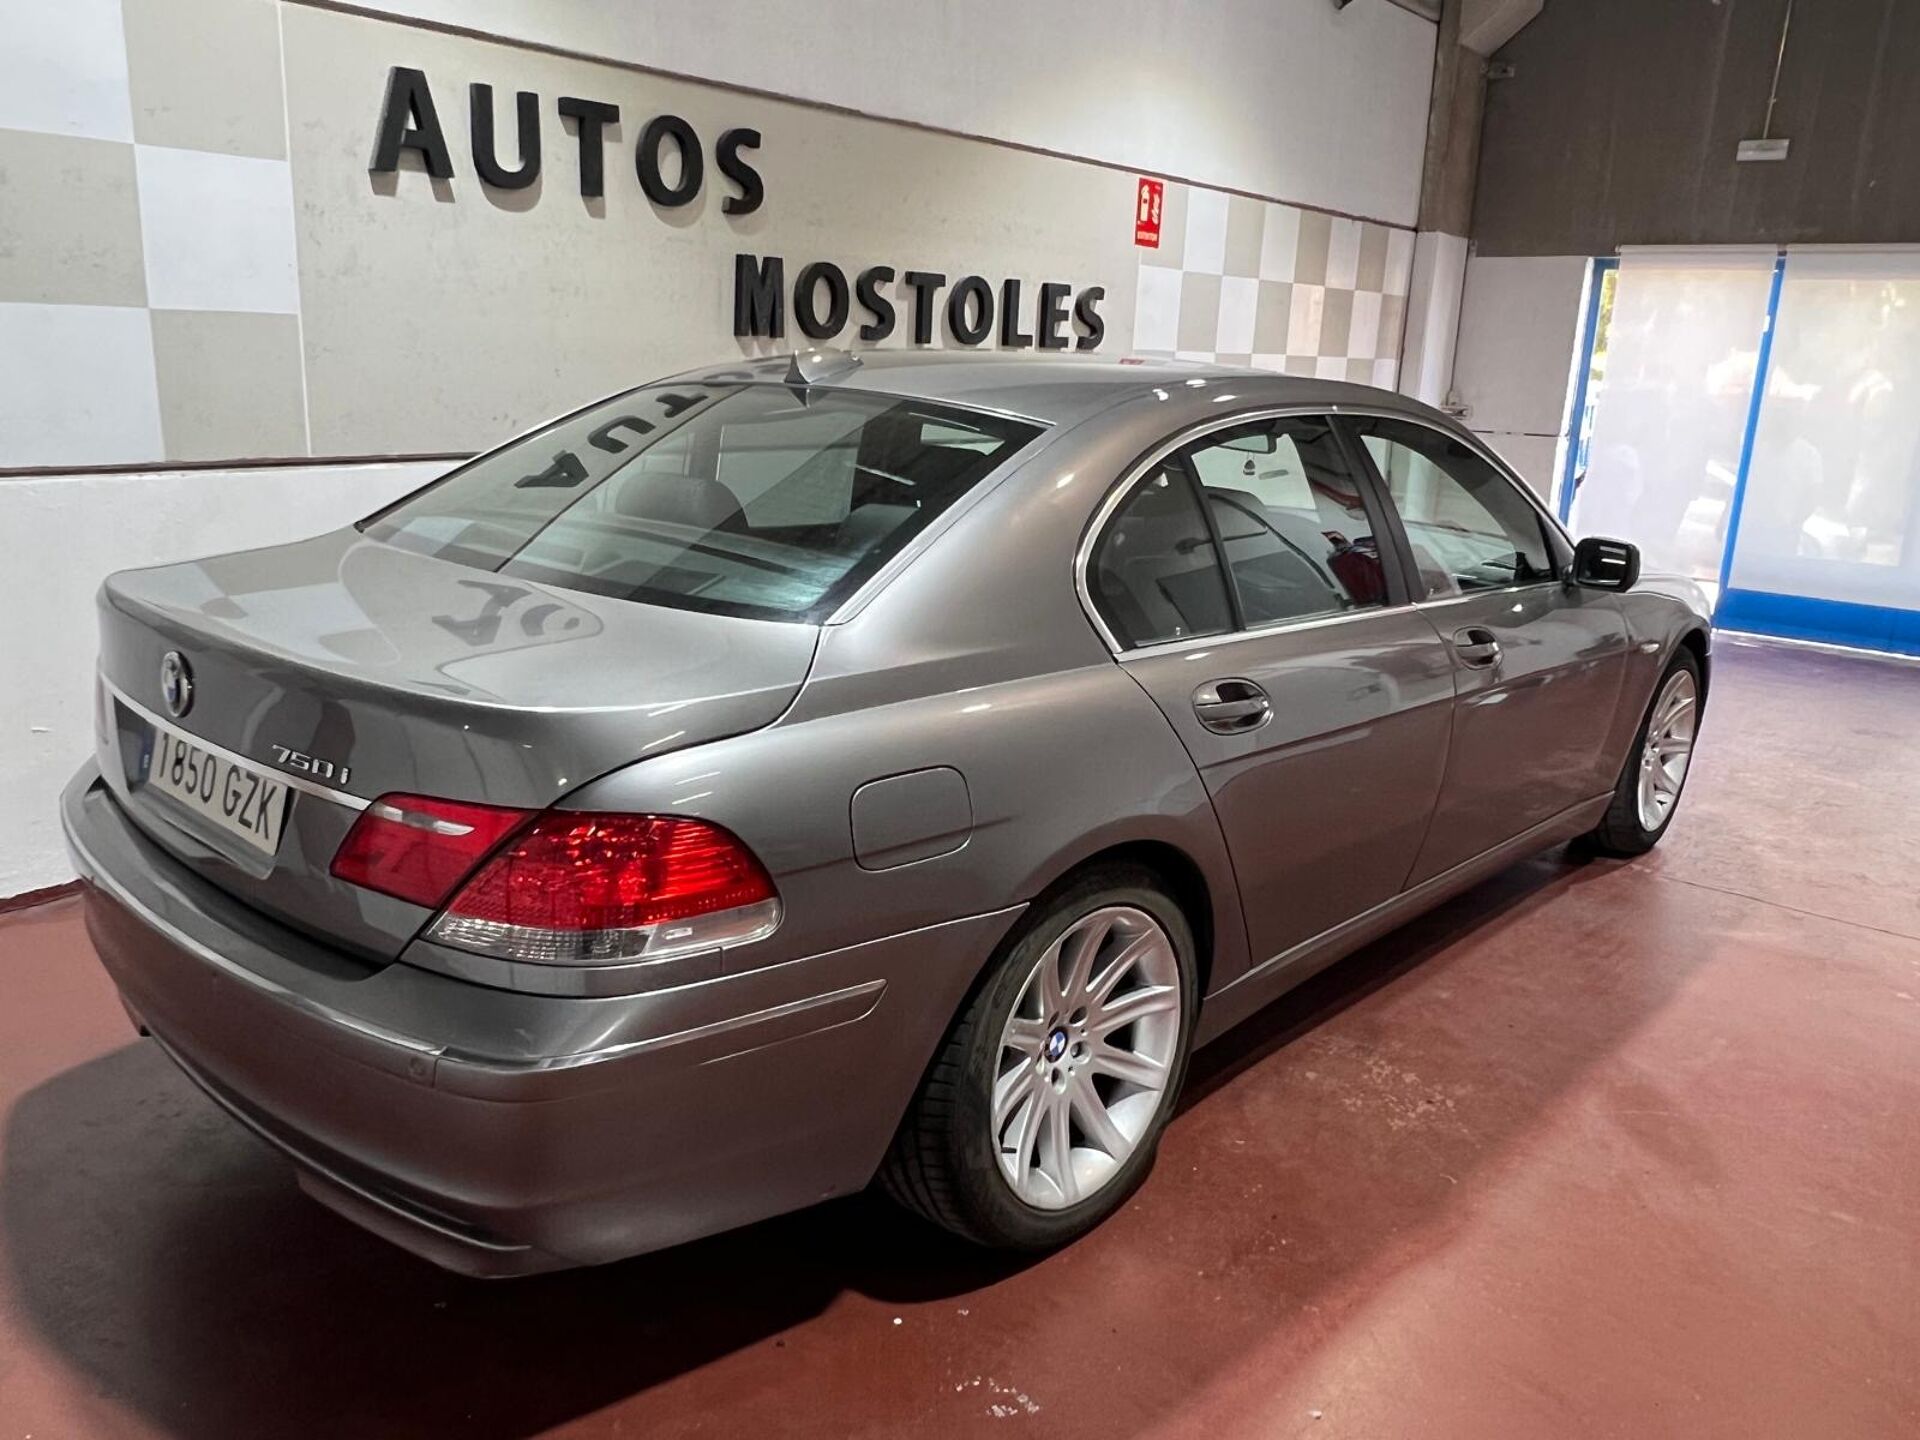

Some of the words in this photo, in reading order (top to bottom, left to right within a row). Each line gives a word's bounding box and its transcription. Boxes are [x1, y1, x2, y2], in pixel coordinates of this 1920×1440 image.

[369, 66, 764, 216] AUTOS
[734, 254, 1105, 350] MOSTOLES
[159, 732, 217, 804] 1850
[223, 764, 277, 840] GZK
[272, 744, 349, 784] 750i
